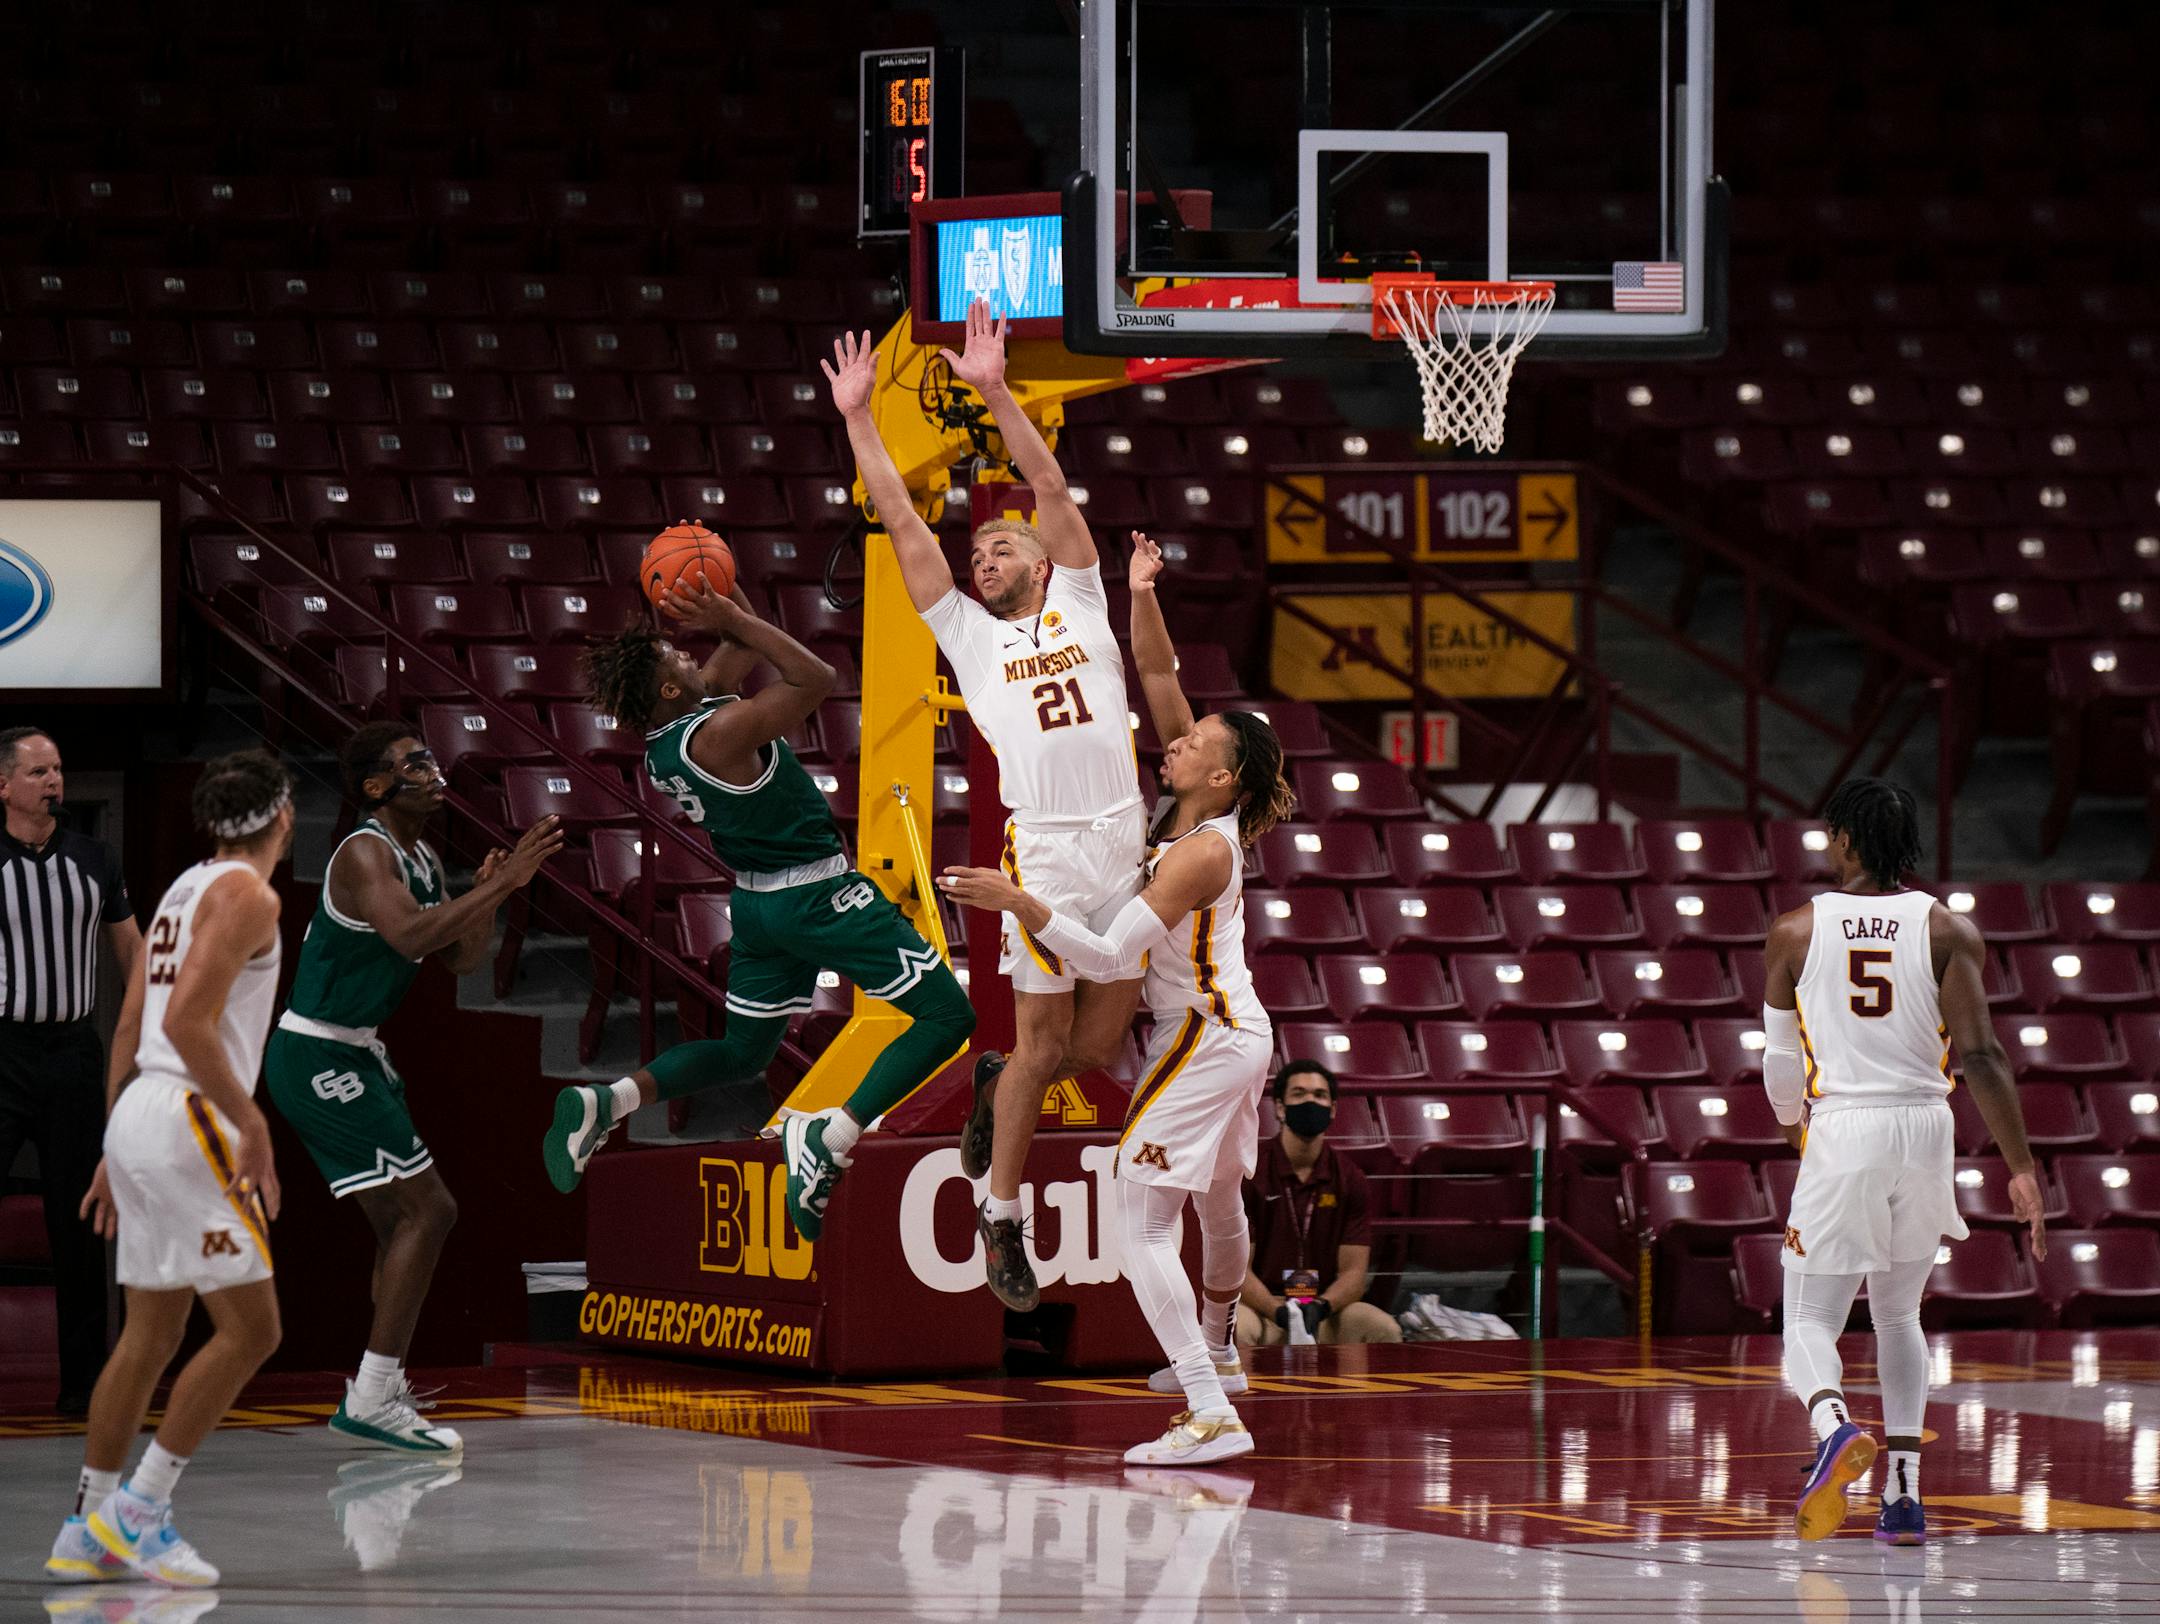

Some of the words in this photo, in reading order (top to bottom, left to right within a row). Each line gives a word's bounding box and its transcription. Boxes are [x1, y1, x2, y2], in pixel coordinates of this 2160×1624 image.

[1116, 314, 1175, 328] SPALDING
[1439, 491, 1511, 539] 102
[1004, 644, 1089, 682] MINNESOTA
[1033, 678, 1093, 732] 21
[1842, 917, 1900, 941] CARR
[1849, 950, 1892, 1017] 5
[311, 1068, 365, 1103] GB
[579, 1291, 812, 1358] GOPHERSPORTS.com
